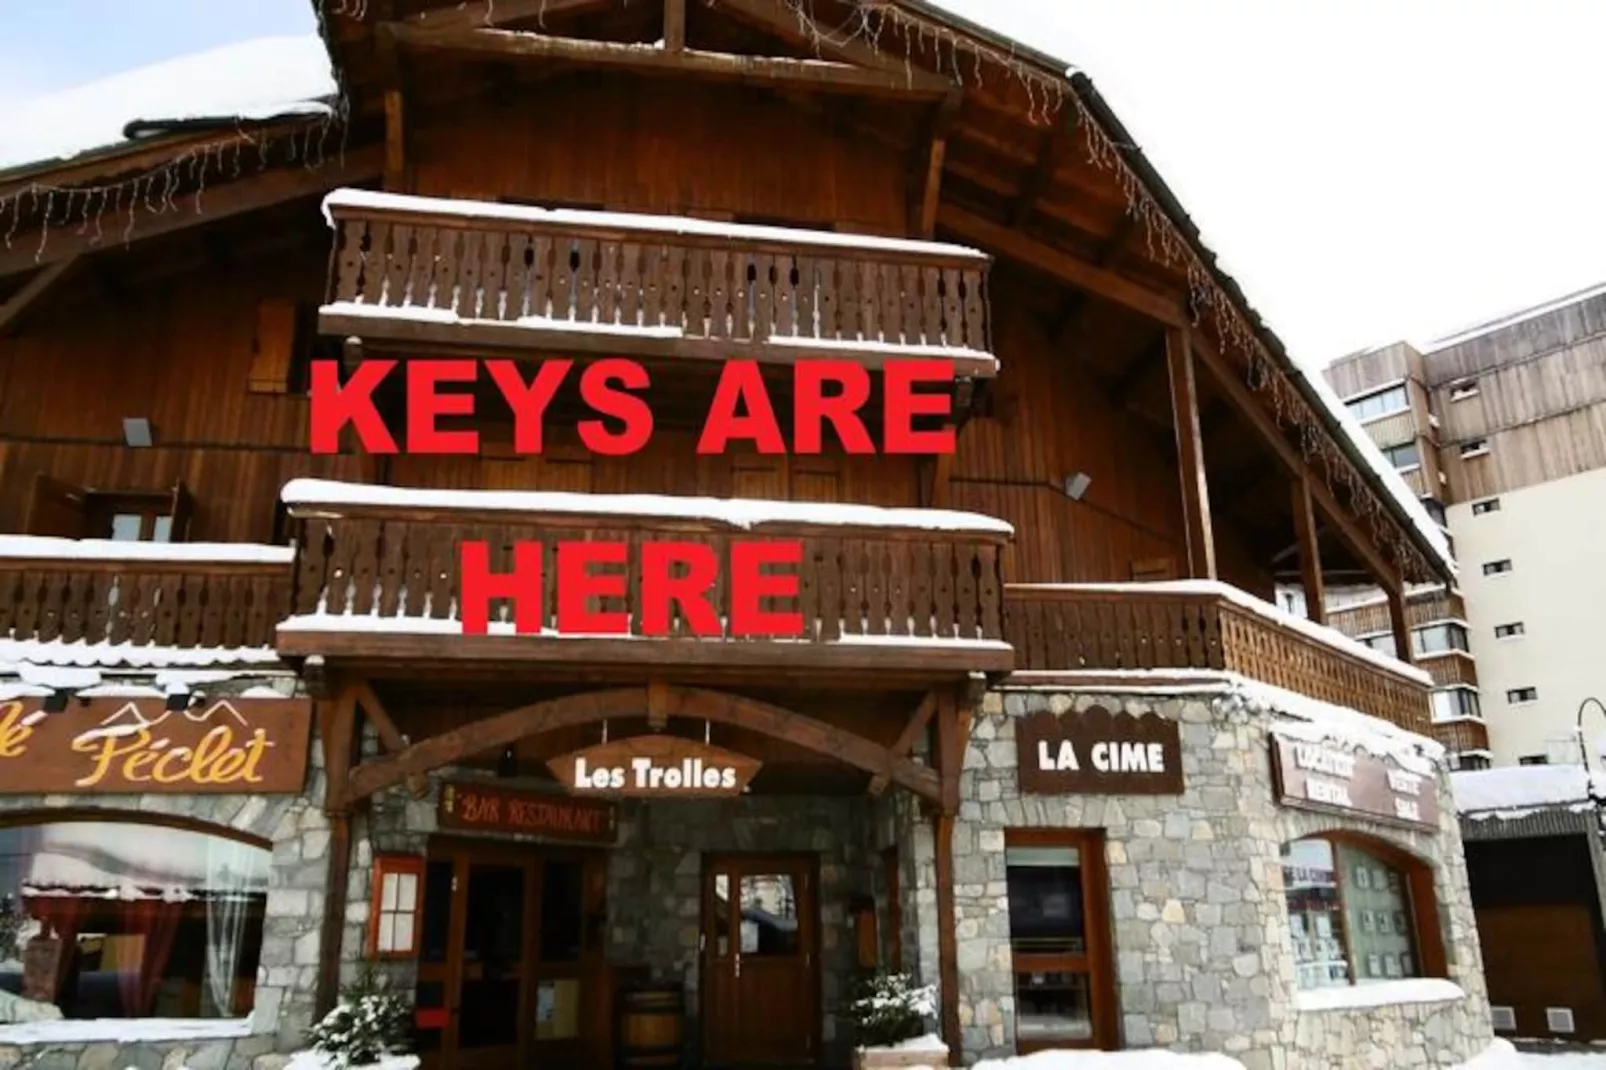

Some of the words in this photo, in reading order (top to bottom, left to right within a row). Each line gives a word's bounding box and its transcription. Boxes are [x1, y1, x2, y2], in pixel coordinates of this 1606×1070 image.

[72, 722, 276, 787] Péclet
[1037, 740, 1080, 772] LA
[1091, 742, 1165, 773] CIME
[574, 757, 625, 789] Les
[632, 757, 737, 789] Trolles
